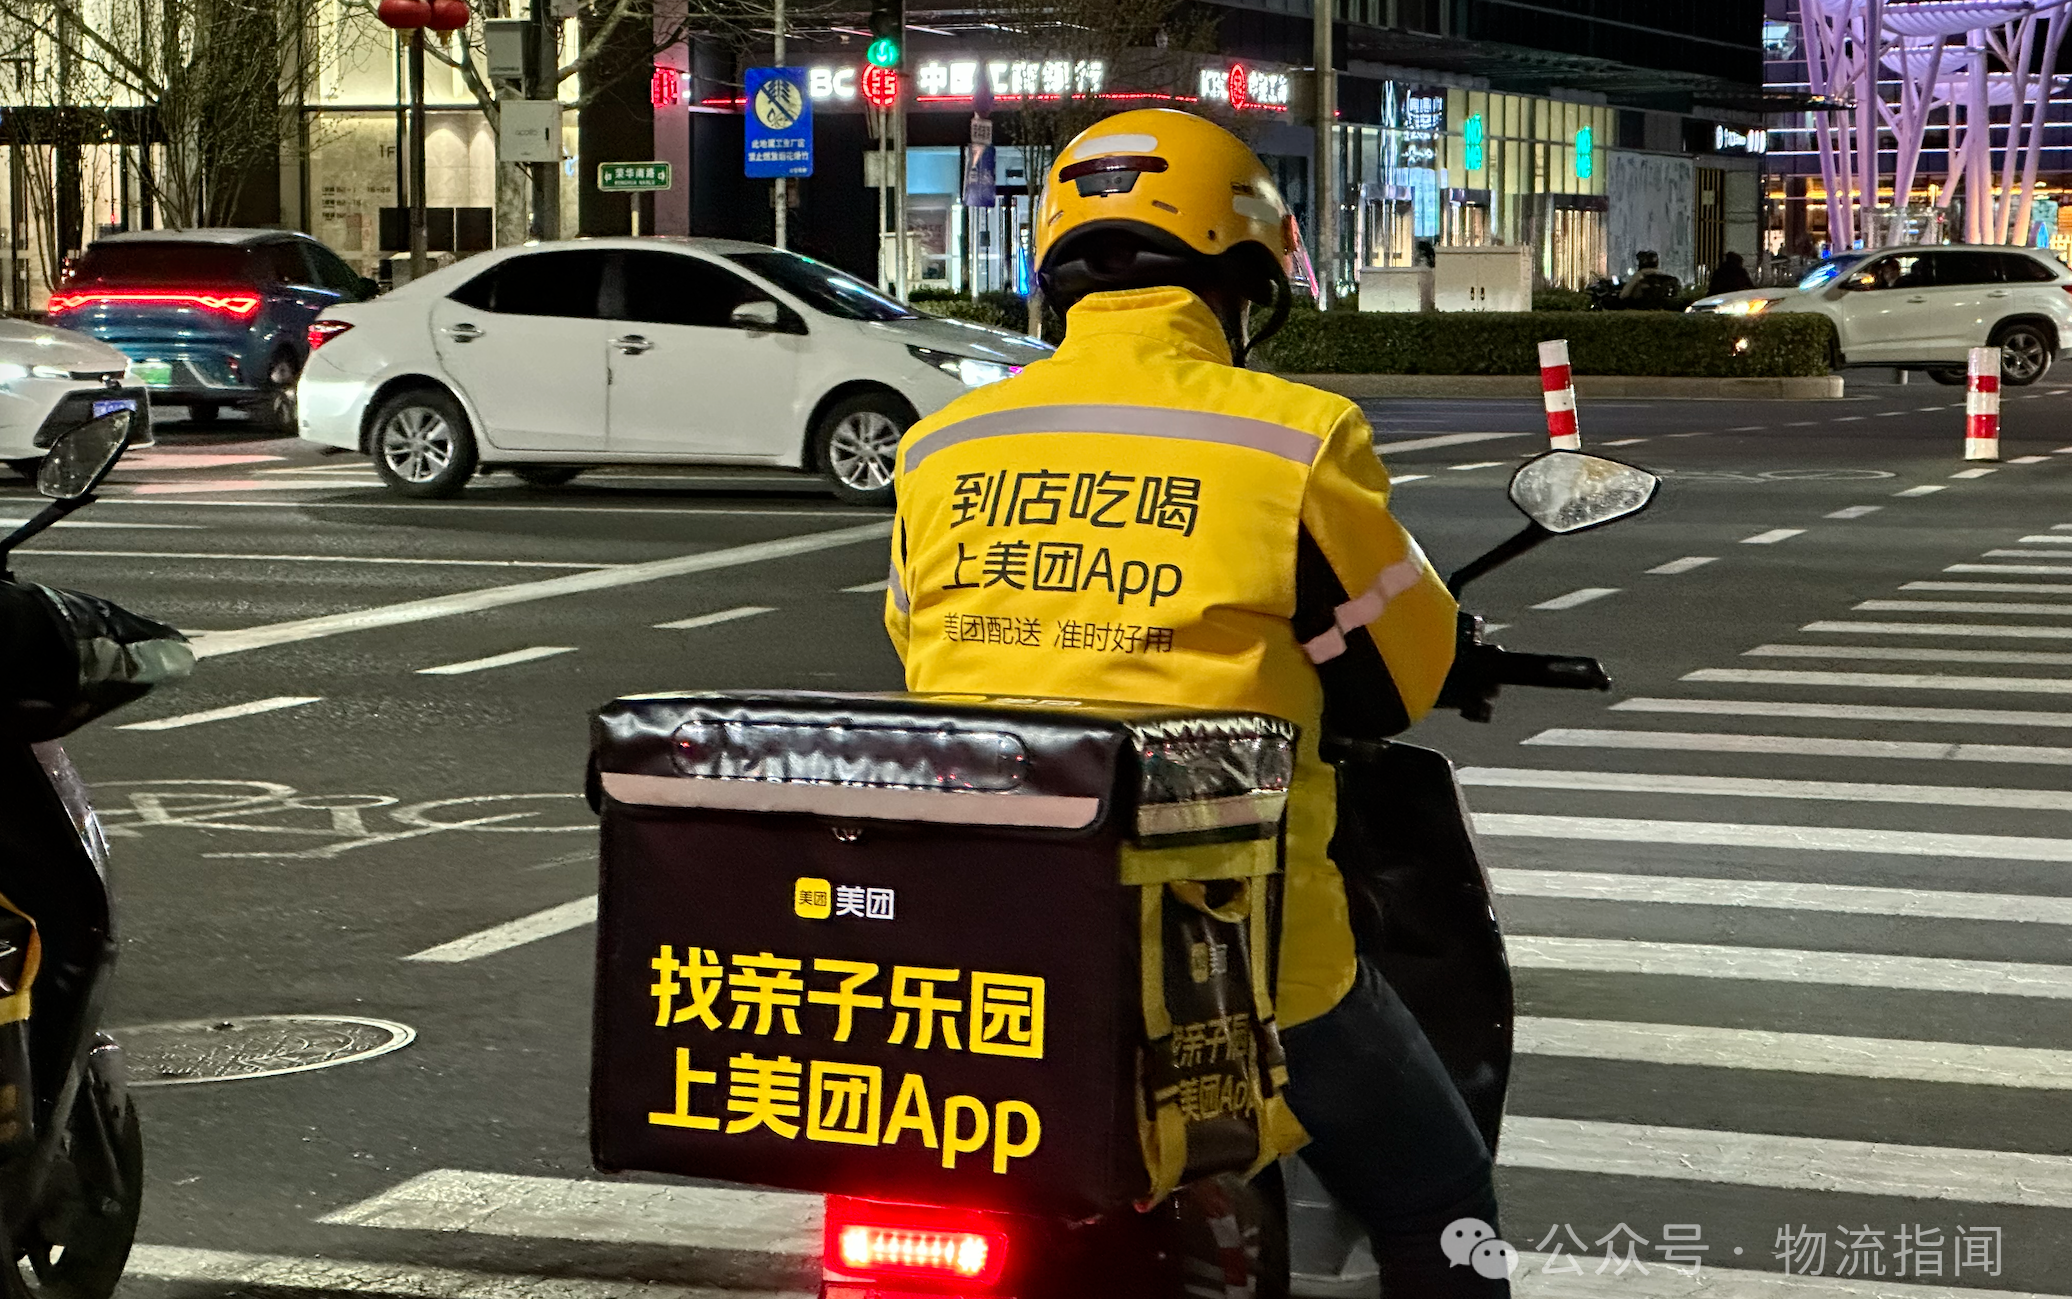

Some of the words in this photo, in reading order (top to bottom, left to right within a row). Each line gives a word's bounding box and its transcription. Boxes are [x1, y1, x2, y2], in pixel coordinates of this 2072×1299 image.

[614, 167, 655, 179] 荣华南路
[950, 469, 1201, 537] 到店吃喝
[942, 540, 1183, 607] 上美团App
[943, 612, 1042, 647] 美团配送
[1054, 619, 1174, 654] 准时好用
[798, 889, 828, 907] 美团
[836, 885, 895, 920] 美团
[650, 944, 1046, 1060] 找亲子乐园
[648, 1047, 1042, 1175] 上美团App
